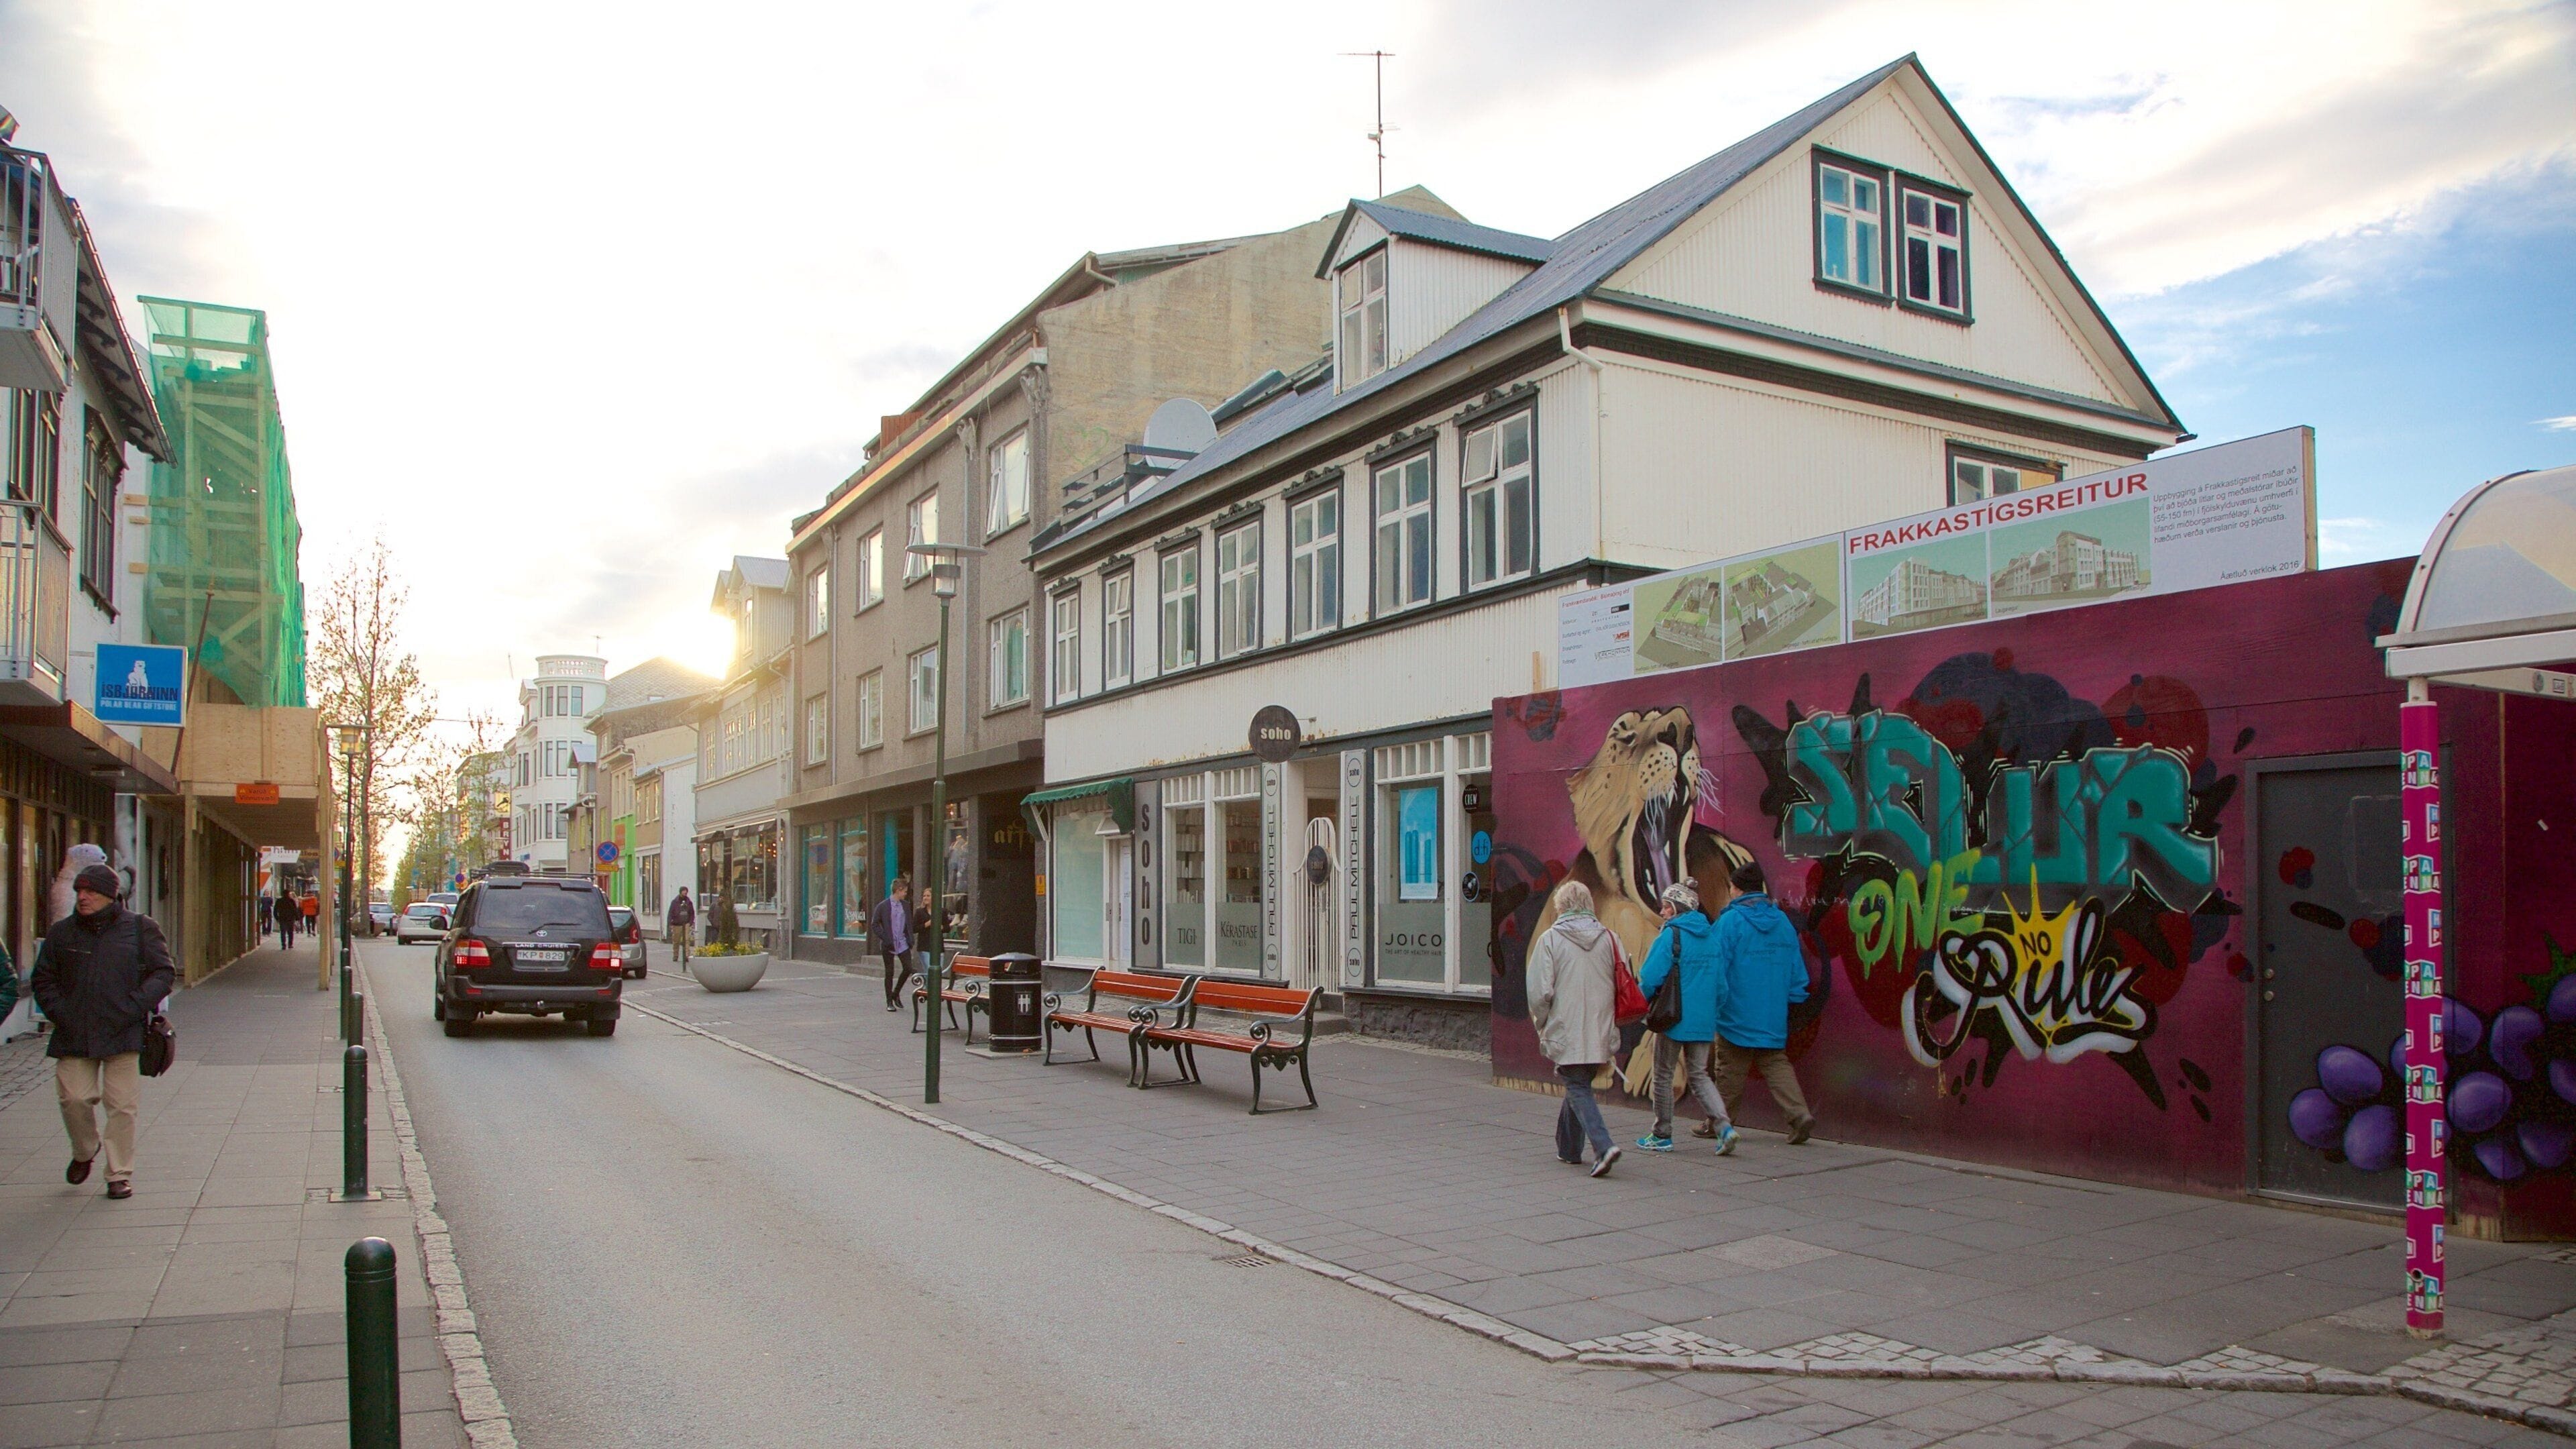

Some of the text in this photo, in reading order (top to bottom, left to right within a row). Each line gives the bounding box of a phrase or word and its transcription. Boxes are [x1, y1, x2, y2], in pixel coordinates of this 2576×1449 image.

[2153, 488, 2196, 502] Uppbygging
[1849, 473, 2148, 554] FRAKKASTÍGSREITUR
[2154, 512, 2181, 524] (55-150
[2259, 490, 2293, 502] umhverfi
[2249, 565, 2277, 575] verklok
[2279, 561, 2299, 570] 2016
[144, 702, 176, 710] GIFTSTORE
[1260, 727, 1291, 740] soho
[1848, 848, 1983, 979] ONE
[1221, 921, 1257, 938] KÉRASTASE
[1385, 933, 1442, 947] JOICO
[2021, 927, 2052, 960] NO
[1902, 898, 2157, 1066] Rules
